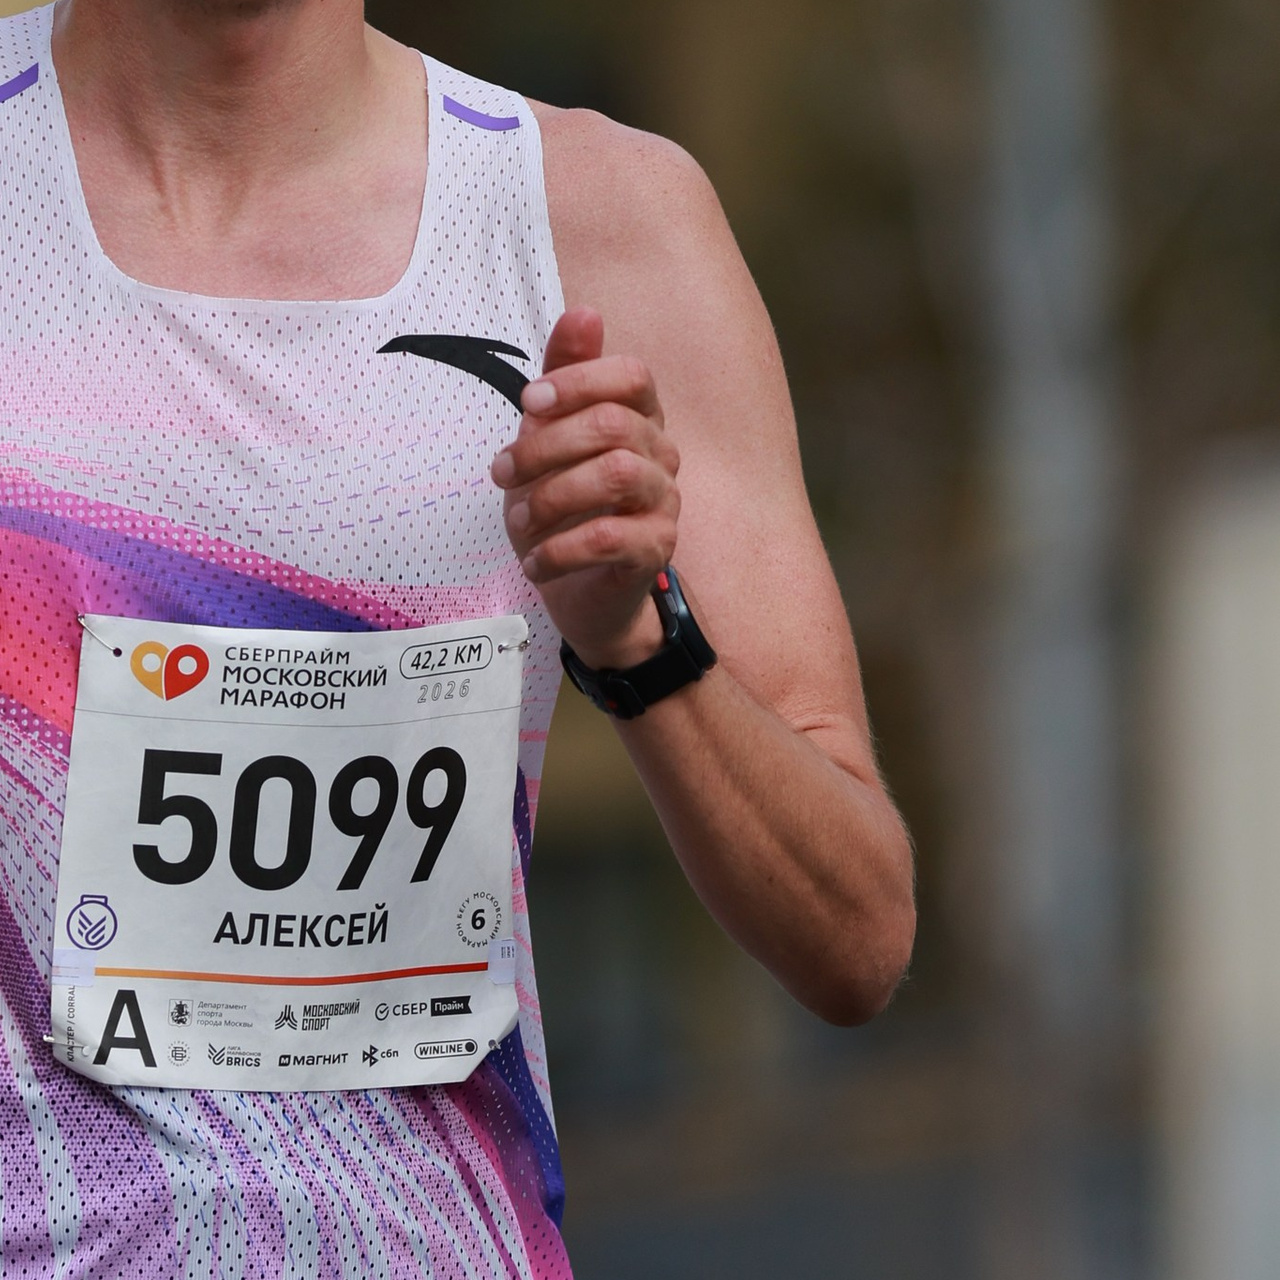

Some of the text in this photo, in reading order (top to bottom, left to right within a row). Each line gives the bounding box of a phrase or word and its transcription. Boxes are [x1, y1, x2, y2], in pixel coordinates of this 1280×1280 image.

[225, 646, 350, 665] СБЕРПРАЙМ
[410, 642, 483, 672] 42,2 КМ
[222, 665, 388, 688] МОСКОВСКИЙ
[220, 687, 346, 710] МАРАФОН
[417, 678, 471, 704] 2026
[132, 746, 468, 892] 5099
[456, 897, 470, 919] БЕГУ
[213, 902, 390, 949] АЛЕКСЕЙ
[471, 908, 486, 931] 6
[456, 922, 488, 948] МАРАФОН
[67, 985, 76, 1019] CORRAL
[197, 1000, 248, 1011] Департамент
[302, 999, 360, 1017] МОСКОВСКИЙ
[392, 1000, 464, 1017] СБЕР Прайм
[196, 1019, 253, 1028] города Москвы
[197, 1010, 223, 1018] спорта
[301, 1017, 331, 1031] СПОРТ
[66, 1026, 75, 1063] КЛАСТЕР
[380, 1048, 399, 1059] сбп
[419, 1042, 464, 1056] WINLINE
[226, 1056, 261, 1068] BRICS
